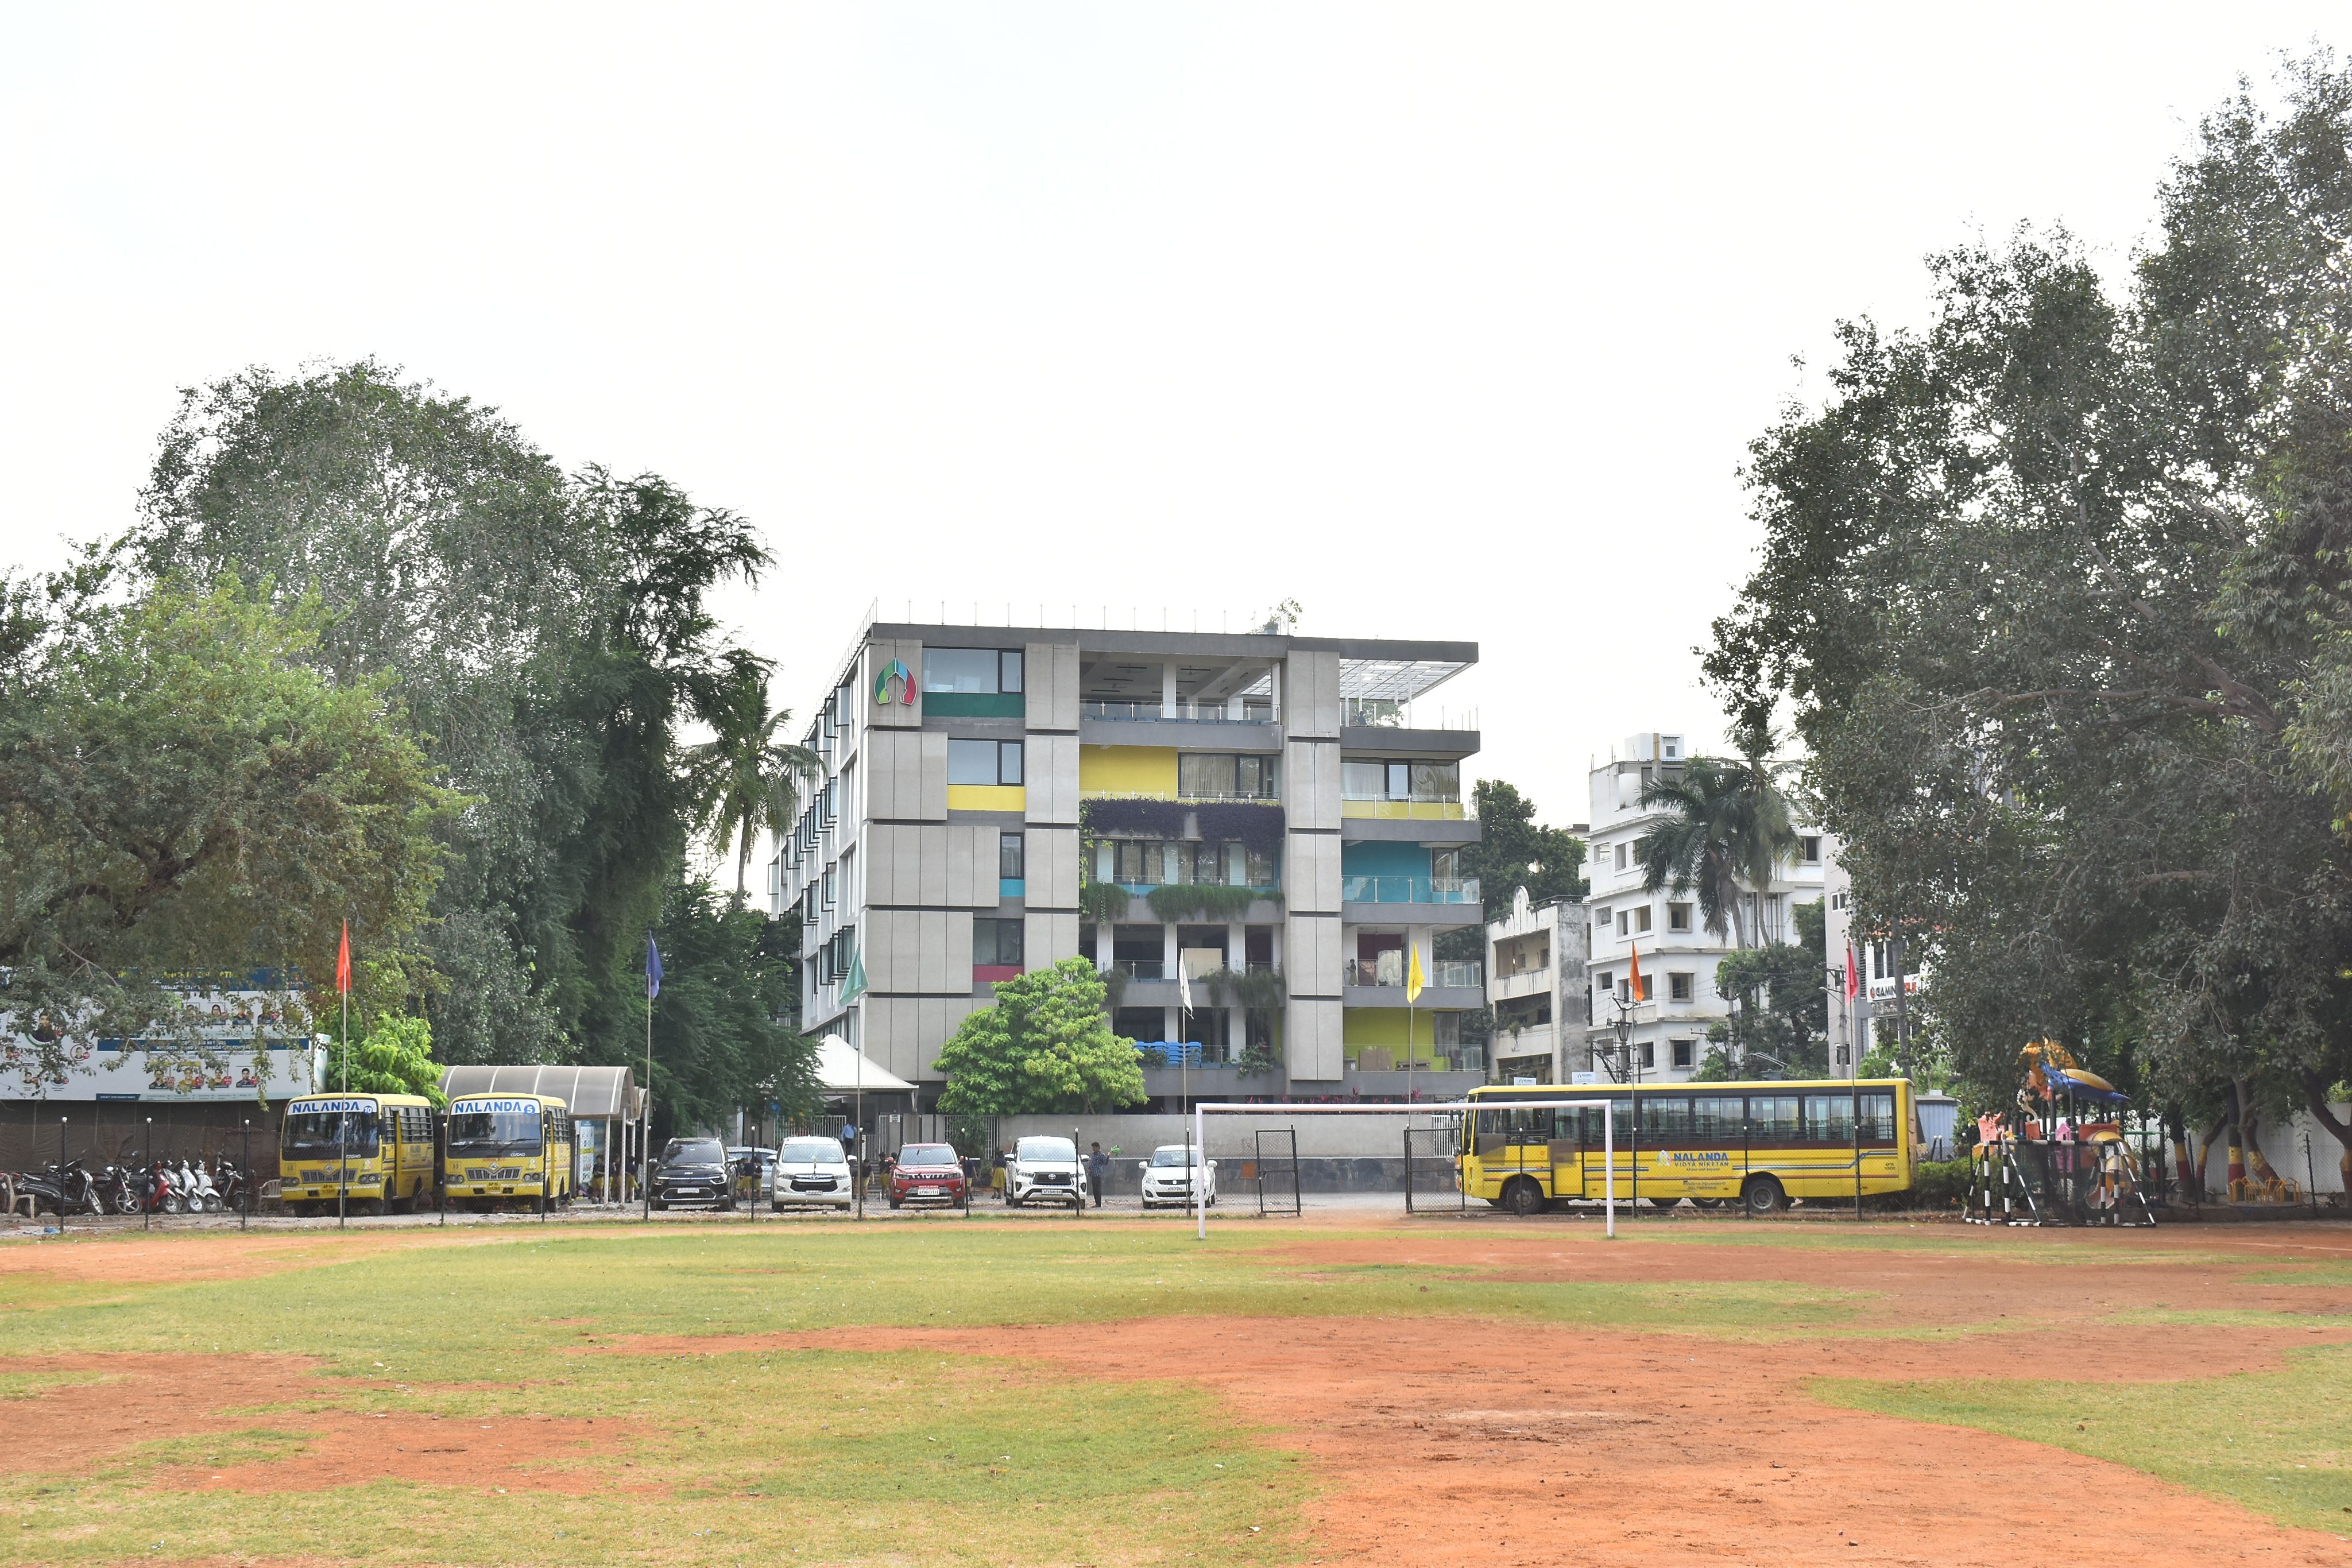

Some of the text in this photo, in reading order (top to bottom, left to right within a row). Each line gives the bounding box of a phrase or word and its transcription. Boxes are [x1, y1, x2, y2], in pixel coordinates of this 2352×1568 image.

[1875, 985, 1896, 997] GAMIN
[293, 1102, 359, 1113] NALANDA
[455, 1102, 521, 1113] NALANDA
[1674, 1153, 1728, 1161] NALANDA
